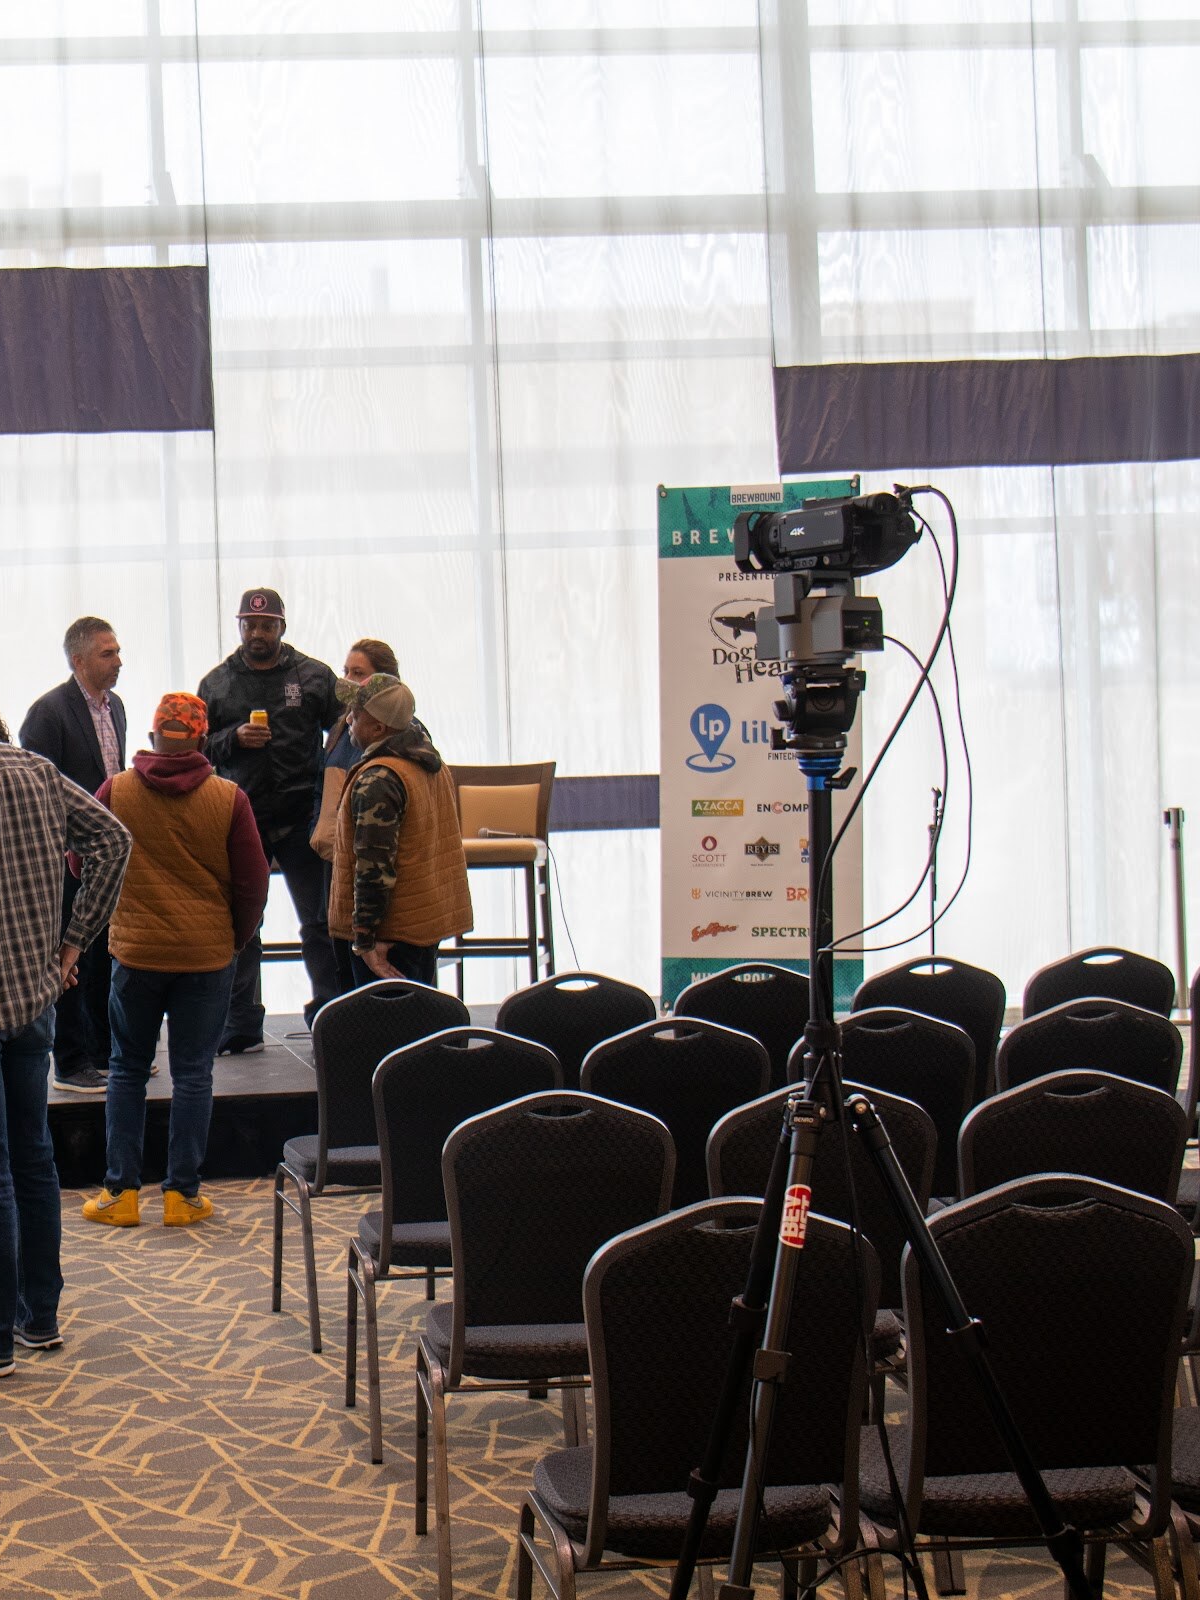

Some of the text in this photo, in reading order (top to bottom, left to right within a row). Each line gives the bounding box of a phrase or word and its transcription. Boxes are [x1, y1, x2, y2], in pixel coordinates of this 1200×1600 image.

[731, 491, 781, 504] BREWBOUND
[789, 527, 806, 537] 4K
[694, 801, 741, 811] AZACCA
[756, 801, 809, 814] ENCOMP
[747, 845, 779, 854] REYES
[691, 854, 727, 863] SCOTT
[751, 926, 809, 938] SPECTR
[780, 1194, 802, 1238] BEV
